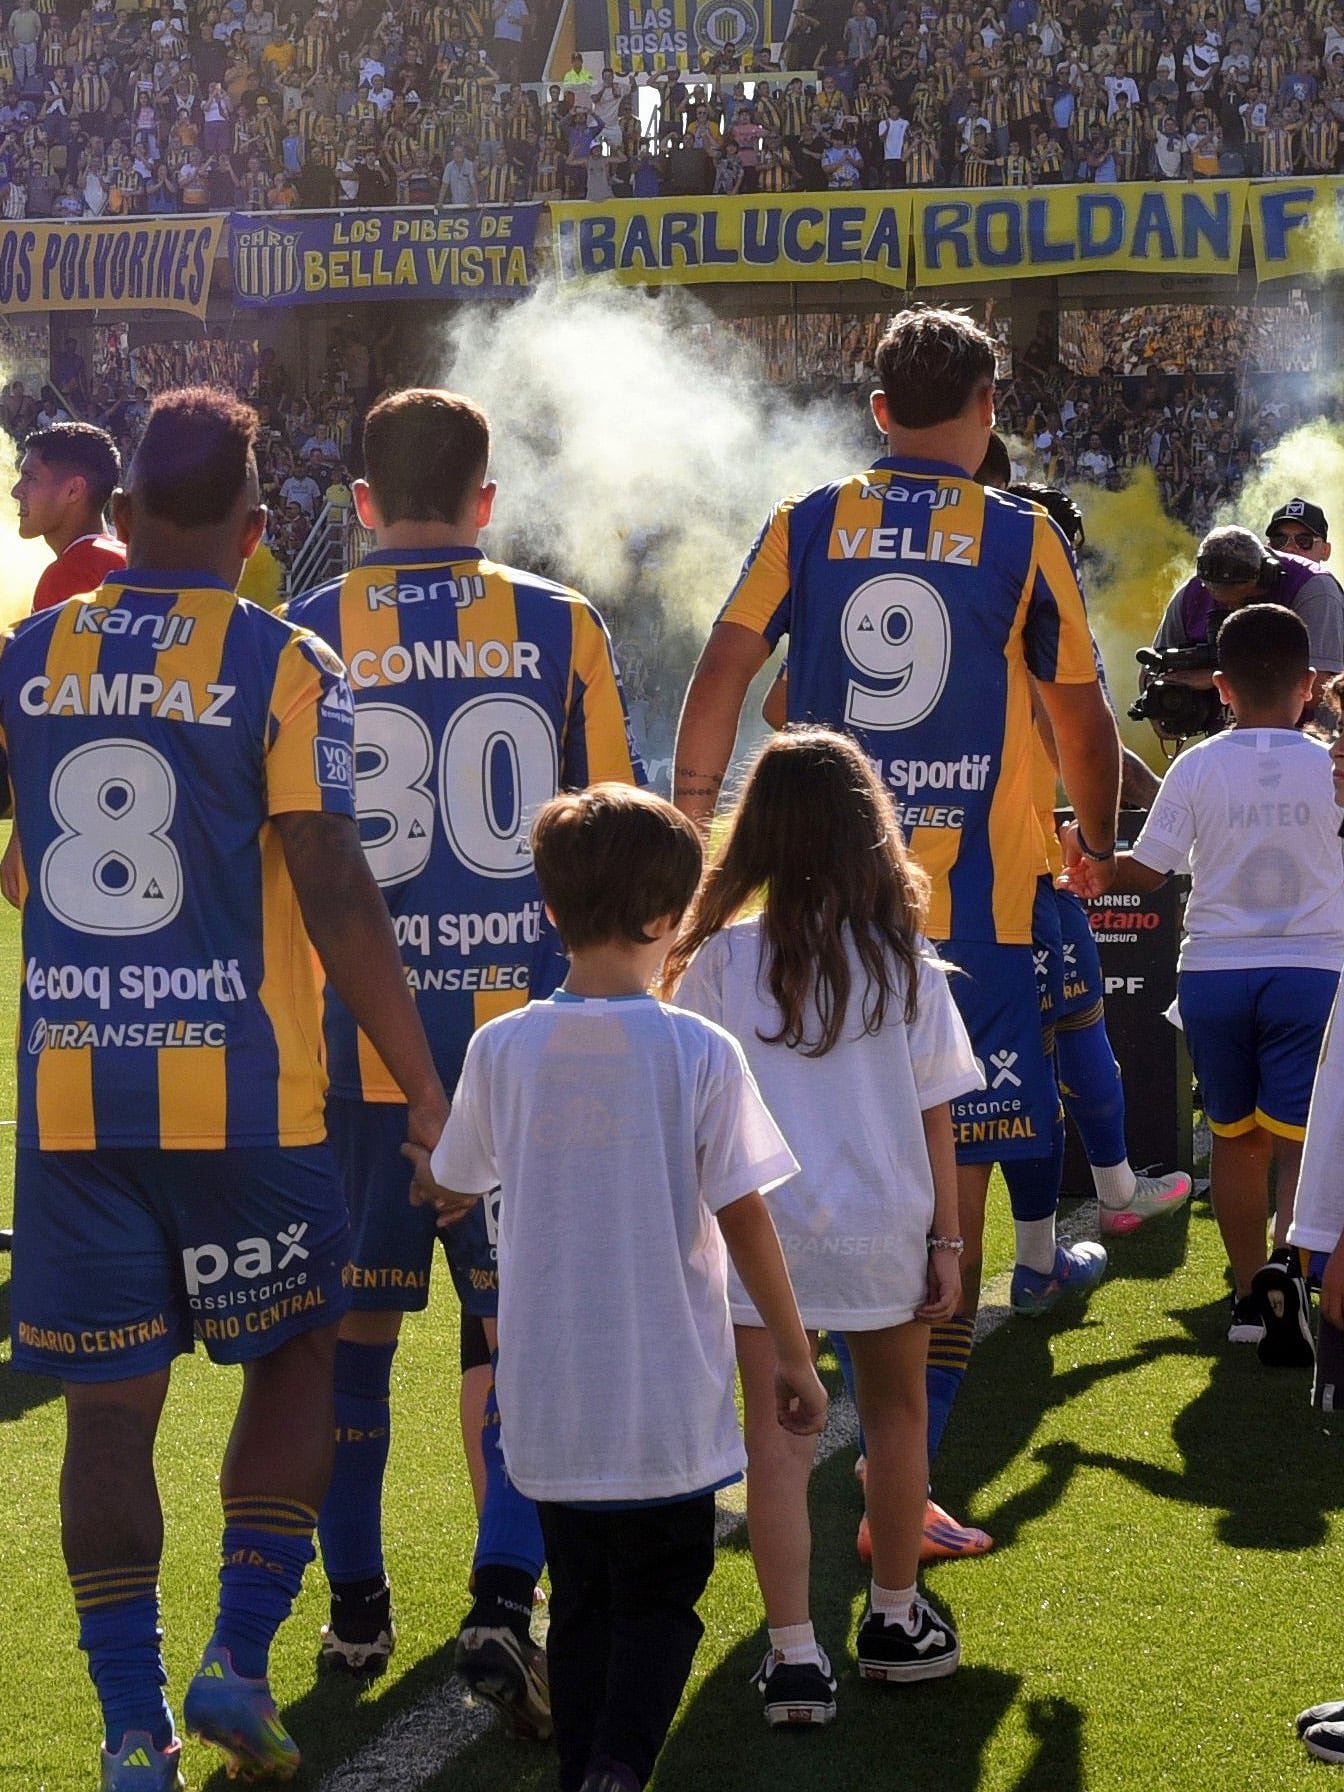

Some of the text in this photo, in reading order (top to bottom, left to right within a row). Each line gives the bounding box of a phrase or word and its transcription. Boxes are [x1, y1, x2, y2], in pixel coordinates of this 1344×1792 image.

[629, 8, 671, 31] LAS
[616, 31, 688, 55] ROSAS
[333, 215, 513, 245] LOS PIBES DE
[923, 190, 1231, 269] ROLDAN
[42, 226, 212, 306] POLVORINES
[303, 246, 529, 292] BELLA VISTA
[861, 482, 960, 511] Kanji
[836, 527, 976, 567] VELIZ
[367, 575, 487, 613] Kanji
[73, 602, 196, 651] Kanji
[351, 641, 542, 688] CONNOR
[840, 573, 952, 732] 9
[18, 673, 237, 728] CAMPAZ
[326, 763, 348, 782] 20
[353, 692, 561, 889] 30
[887, 754, 991, 796] sportif
[895, 805, 965, 829] SELEC
[1227, 801, 1312, 829] MATEO
[39, 737, 185, 937] 8
[438, 901, 544, 956] sporti
[1088, 910, 1161, 930] etano
[1094, 931, 1138, 943] lausura
[119, 956, 248, 1009] sportif
[406, 965, 530, 991] ANSELEC
[1103, 976, 1145, 995] PF
[44, 1018, 228, 1048] TRANSELEC
[951, 1099, 1021, 1117] istance
[189, 1271, 307, 1311] assistance
[245, 1285, 326, 1334] CENTRAL
[18, 1312, 169, 1355] ROSARIO CENTRAL
